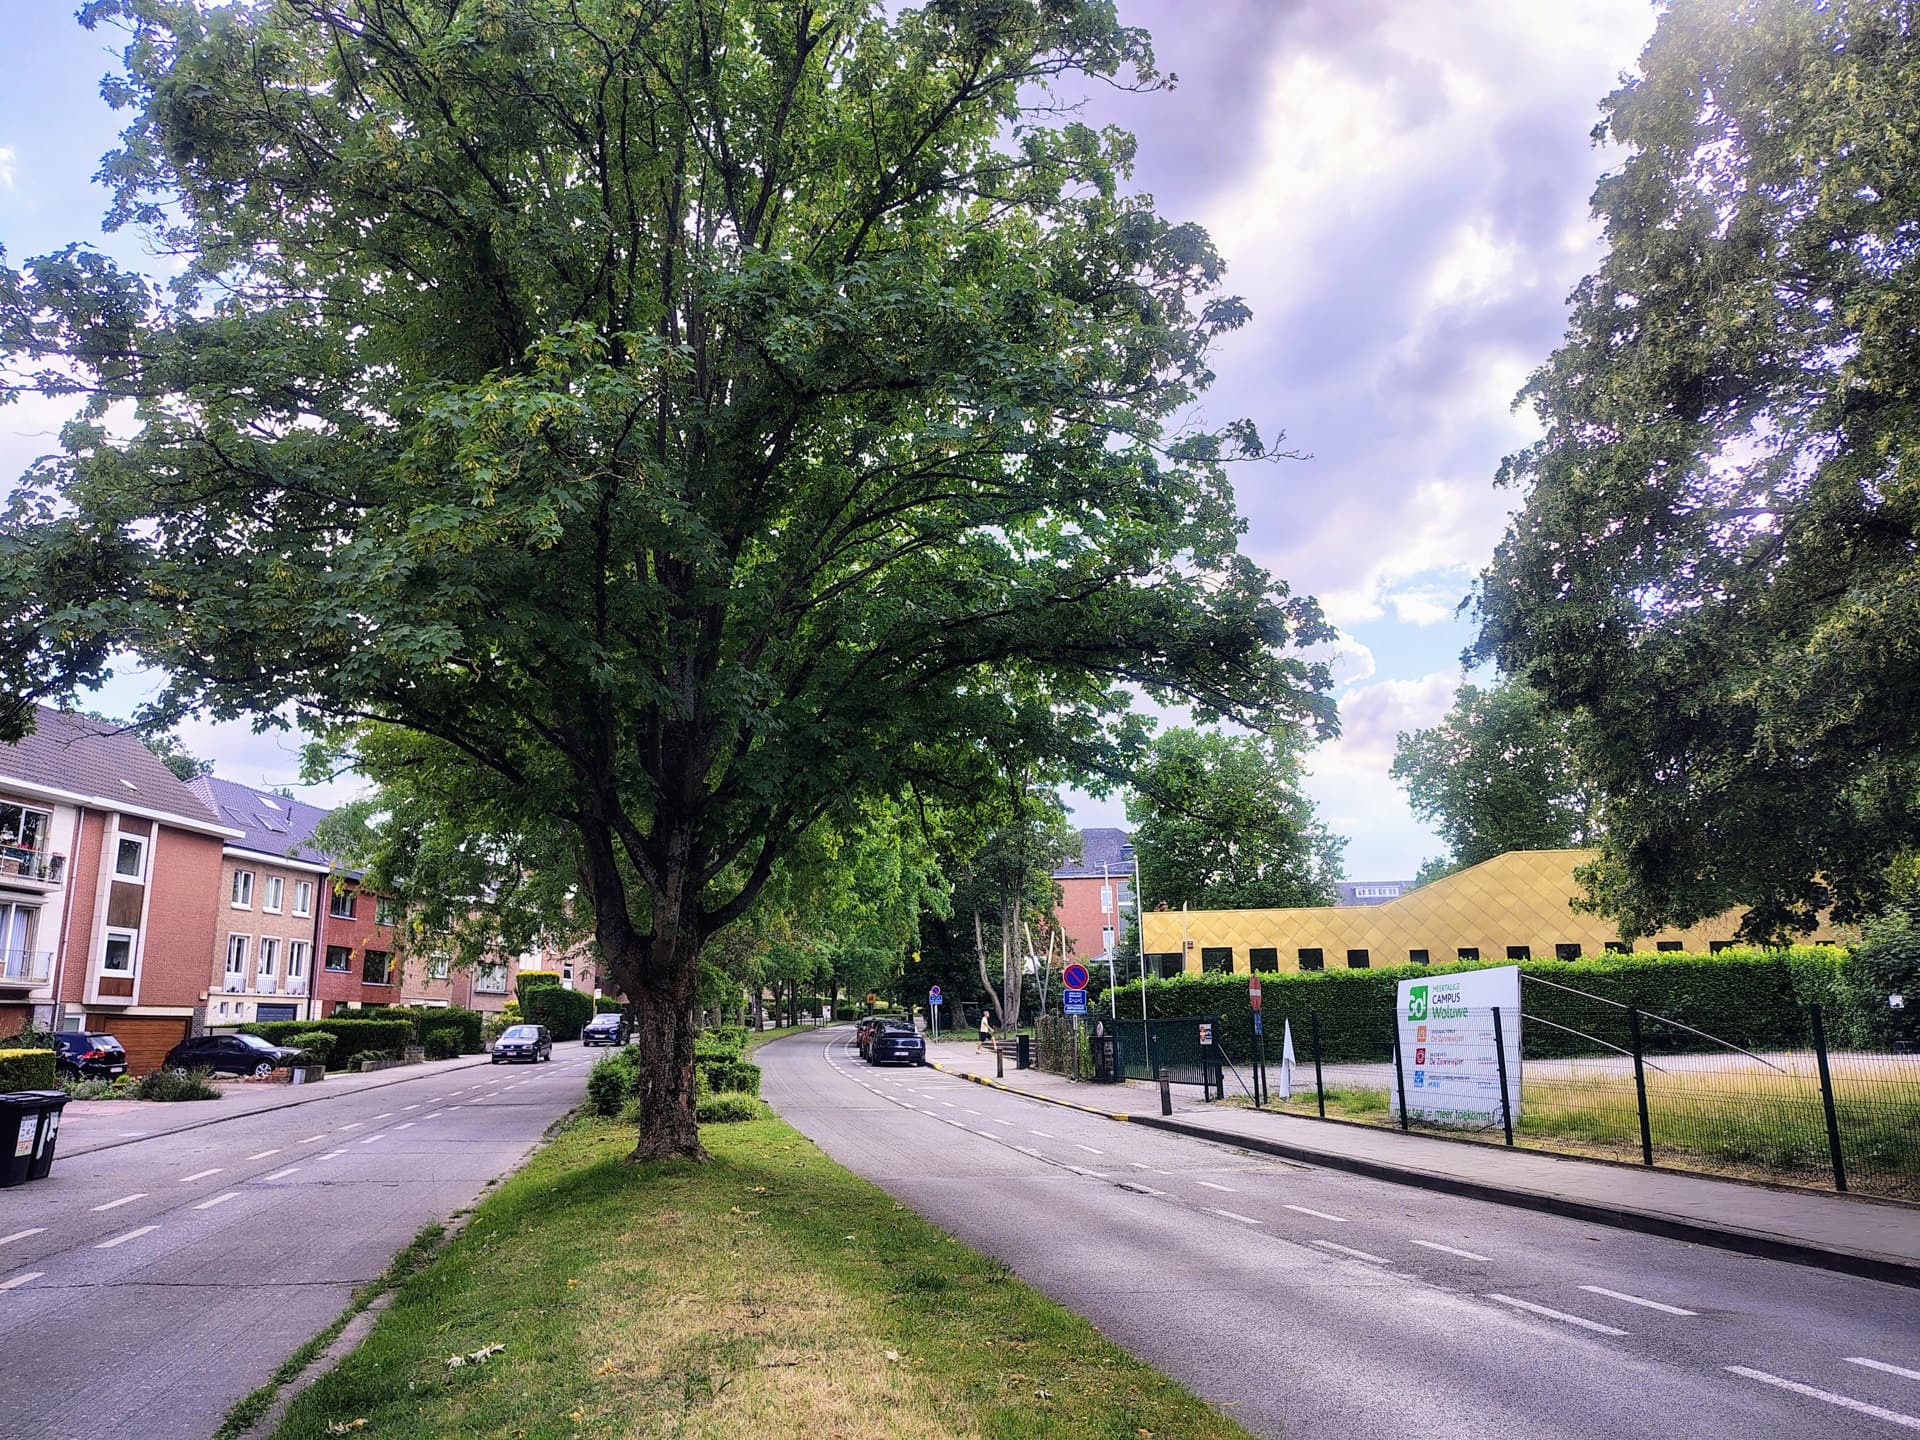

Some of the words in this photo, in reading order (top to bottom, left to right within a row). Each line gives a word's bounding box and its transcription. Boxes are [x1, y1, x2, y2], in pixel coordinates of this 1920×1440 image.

[1409, 991, 1426, 1018] GO!
[1432, 992, 1460, 1005] CAMPUS
[1432, 1004, 1468, 1019] Woluwe
[1412, 1106, 1424, 1118] taal
[1435, 1110, 1453, 1119] meer
[1455, 1109, 1490, 1120] toekomst
